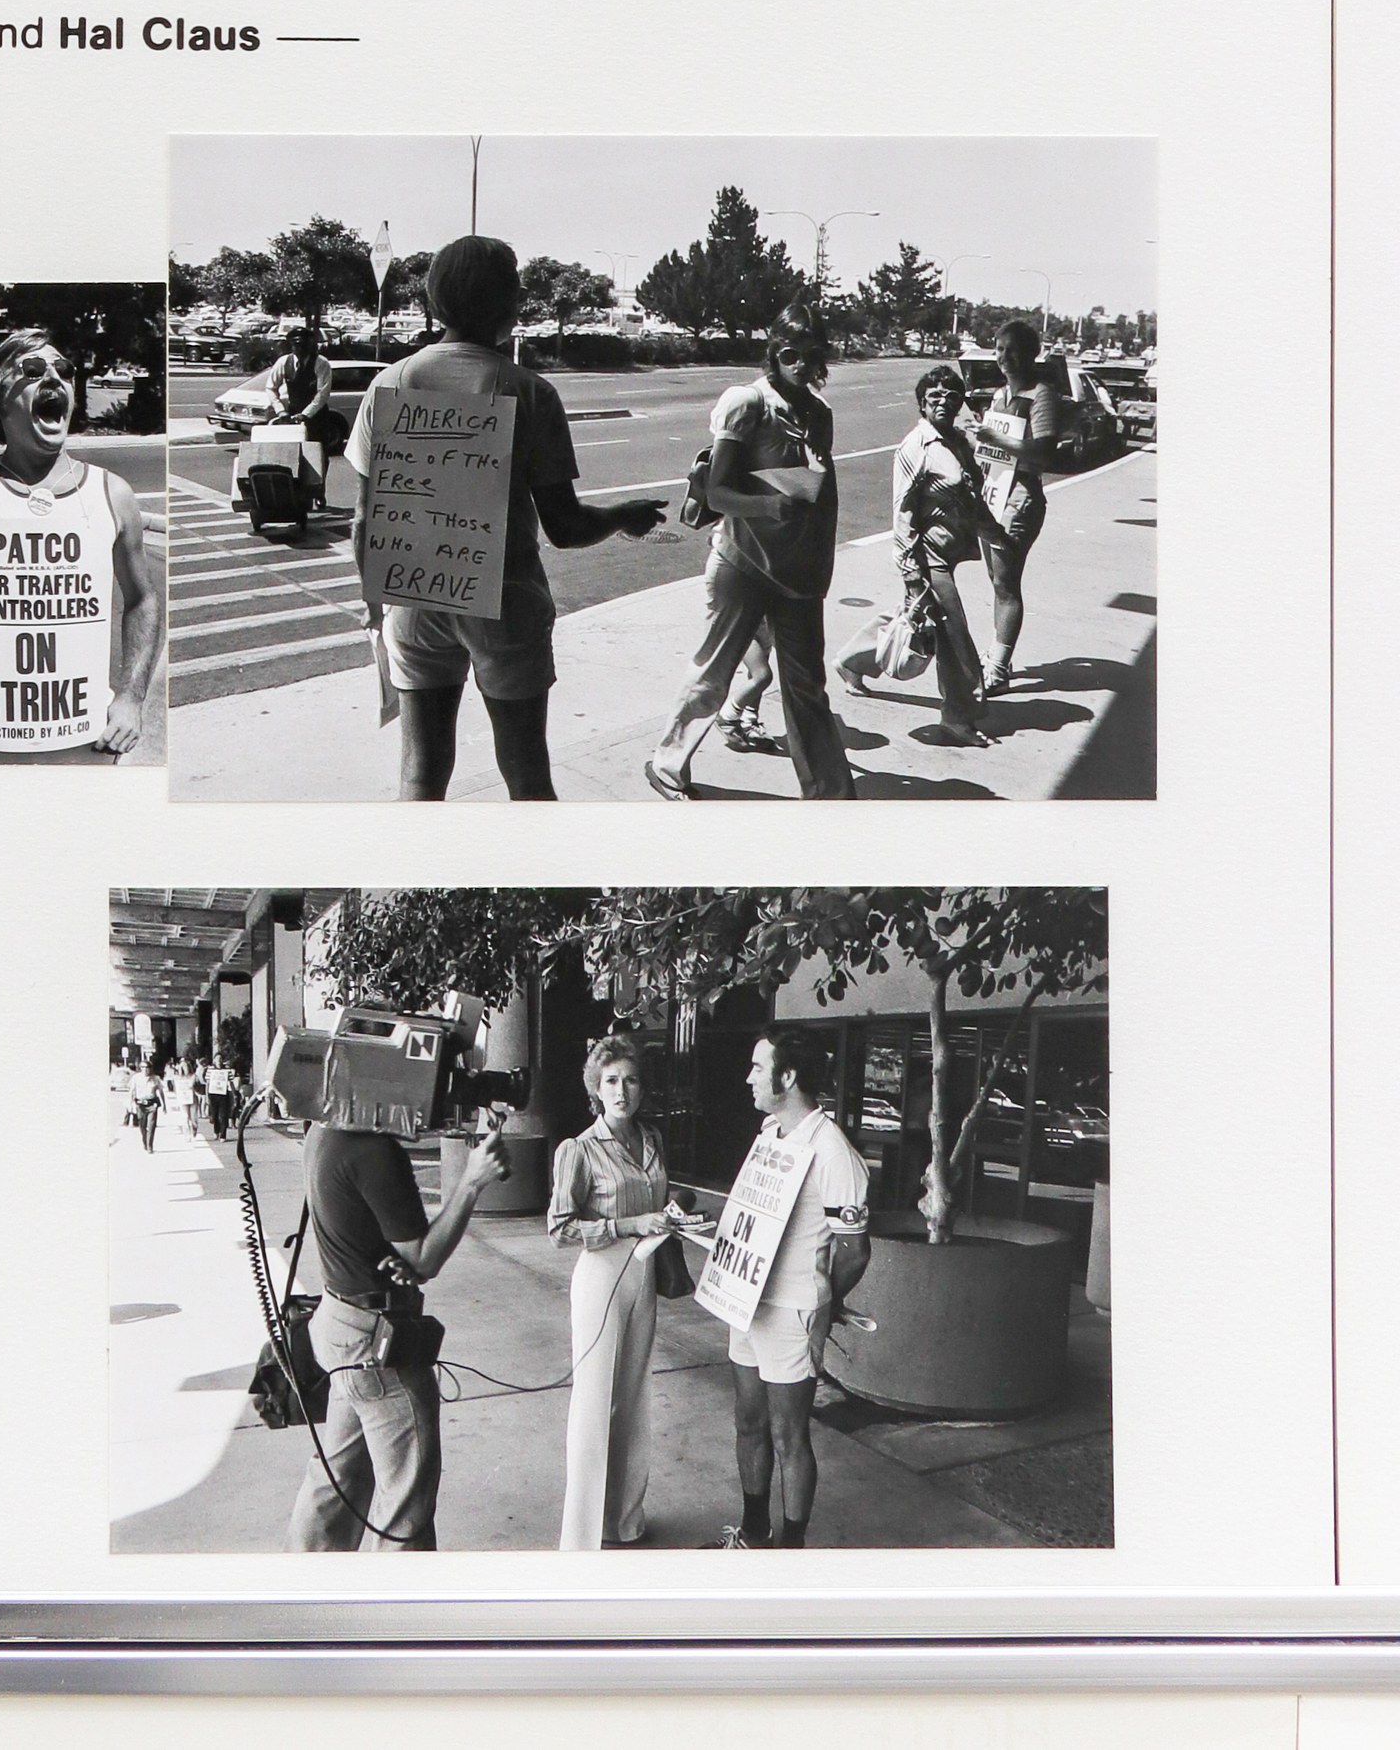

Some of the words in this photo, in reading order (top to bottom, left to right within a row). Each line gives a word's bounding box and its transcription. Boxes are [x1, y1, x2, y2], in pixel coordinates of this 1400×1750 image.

[61, 17, 123, 50] Hal
[143, 17, 260, 51] Claus
[372, 504, 416, 525] FOR
[436, 544, 488, 564] ARE
[15, 573, 92, 595] TRAFFIC
[385, 563, 479, 601] BRAVE
[15, 632, 56, 675] ON
[40, 727, 52, 739] BY
[57, 721, 90, 736] AFL-CIO
[752, 1170, 785, 1194] TRAFFIC
[732, 1211, 757, 1244] ON
[712, 1236, 766, 1287] STRIKE
